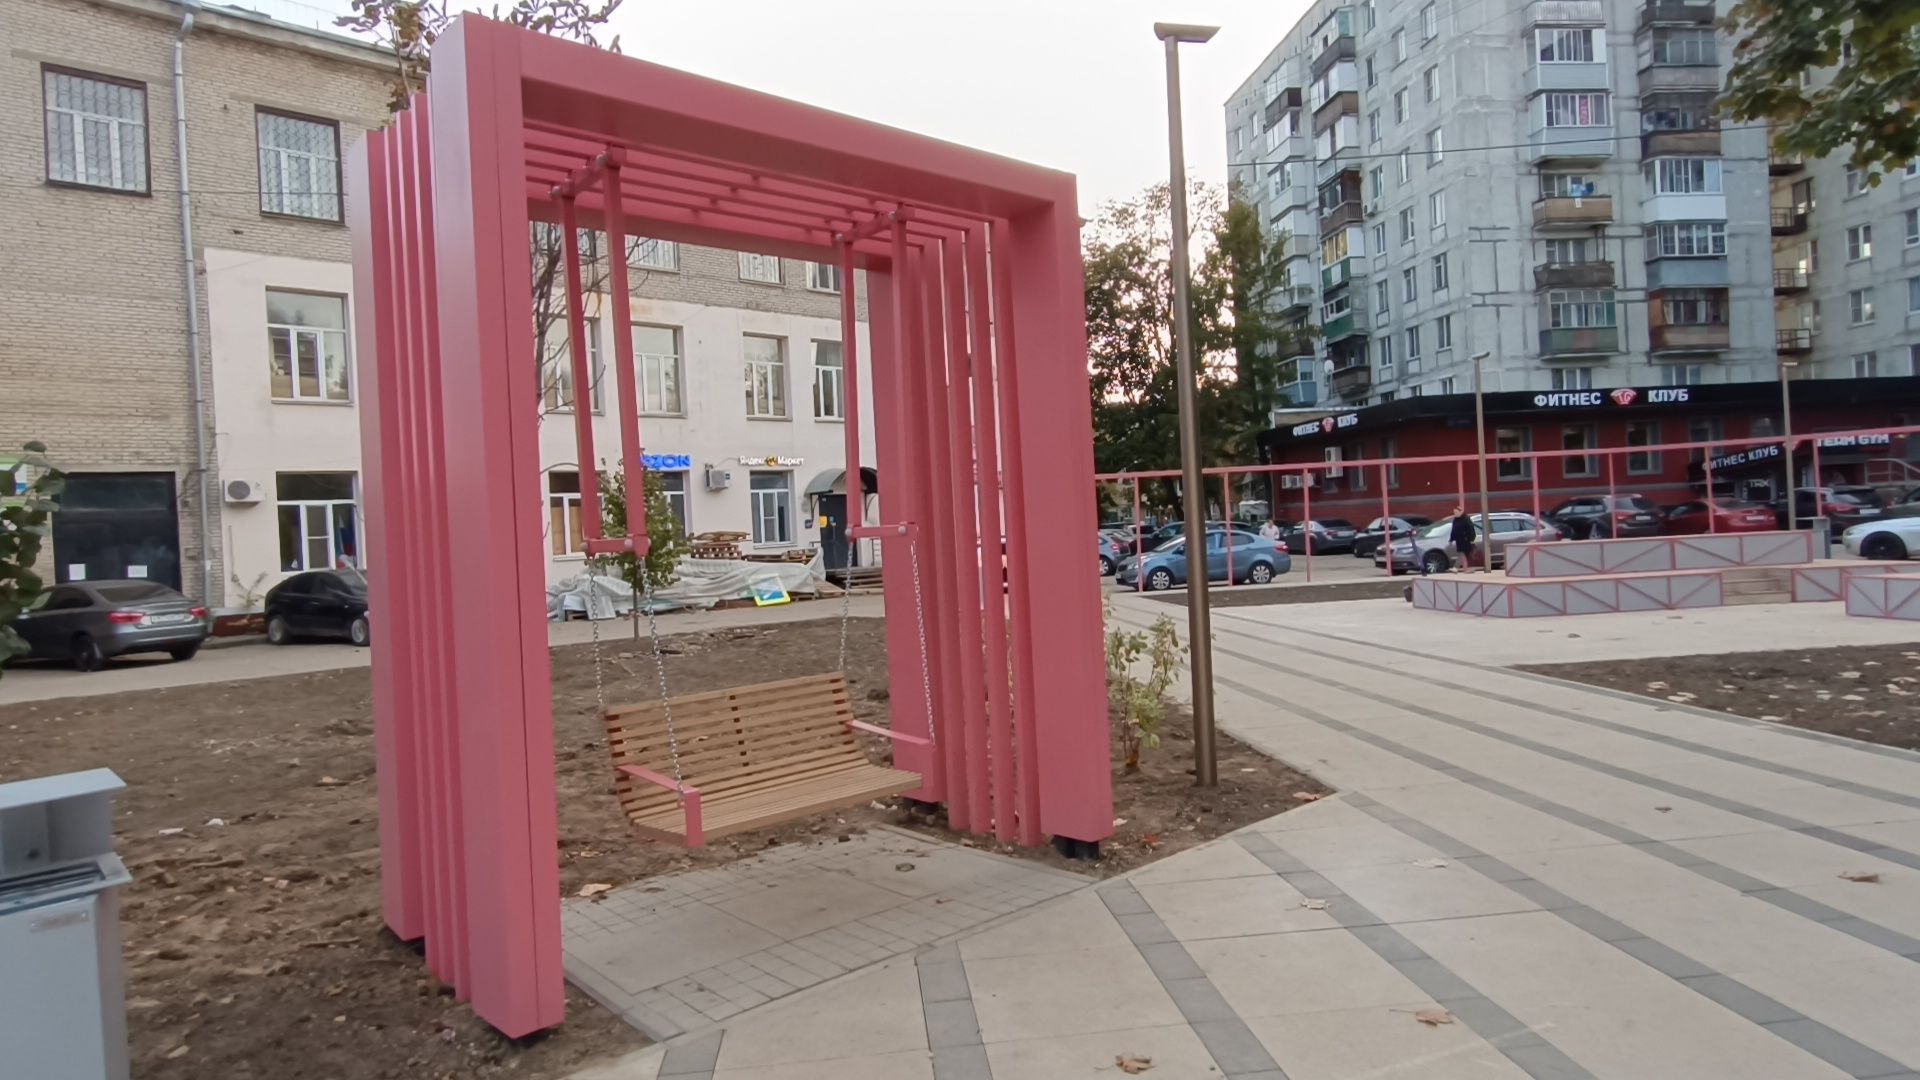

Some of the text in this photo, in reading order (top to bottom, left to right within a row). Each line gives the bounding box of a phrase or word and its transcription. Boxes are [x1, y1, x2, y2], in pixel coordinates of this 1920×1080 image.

[1534, 388, 1689, 407] ФИТНЕС КЛУБ
[1858, 434, 1889, 445] GYM
[739, 455, 804, 466] Яндекс Маркет
[1748, 445, 1778, 461] КЛУБ
[642, 454, 690, 469] OZON
